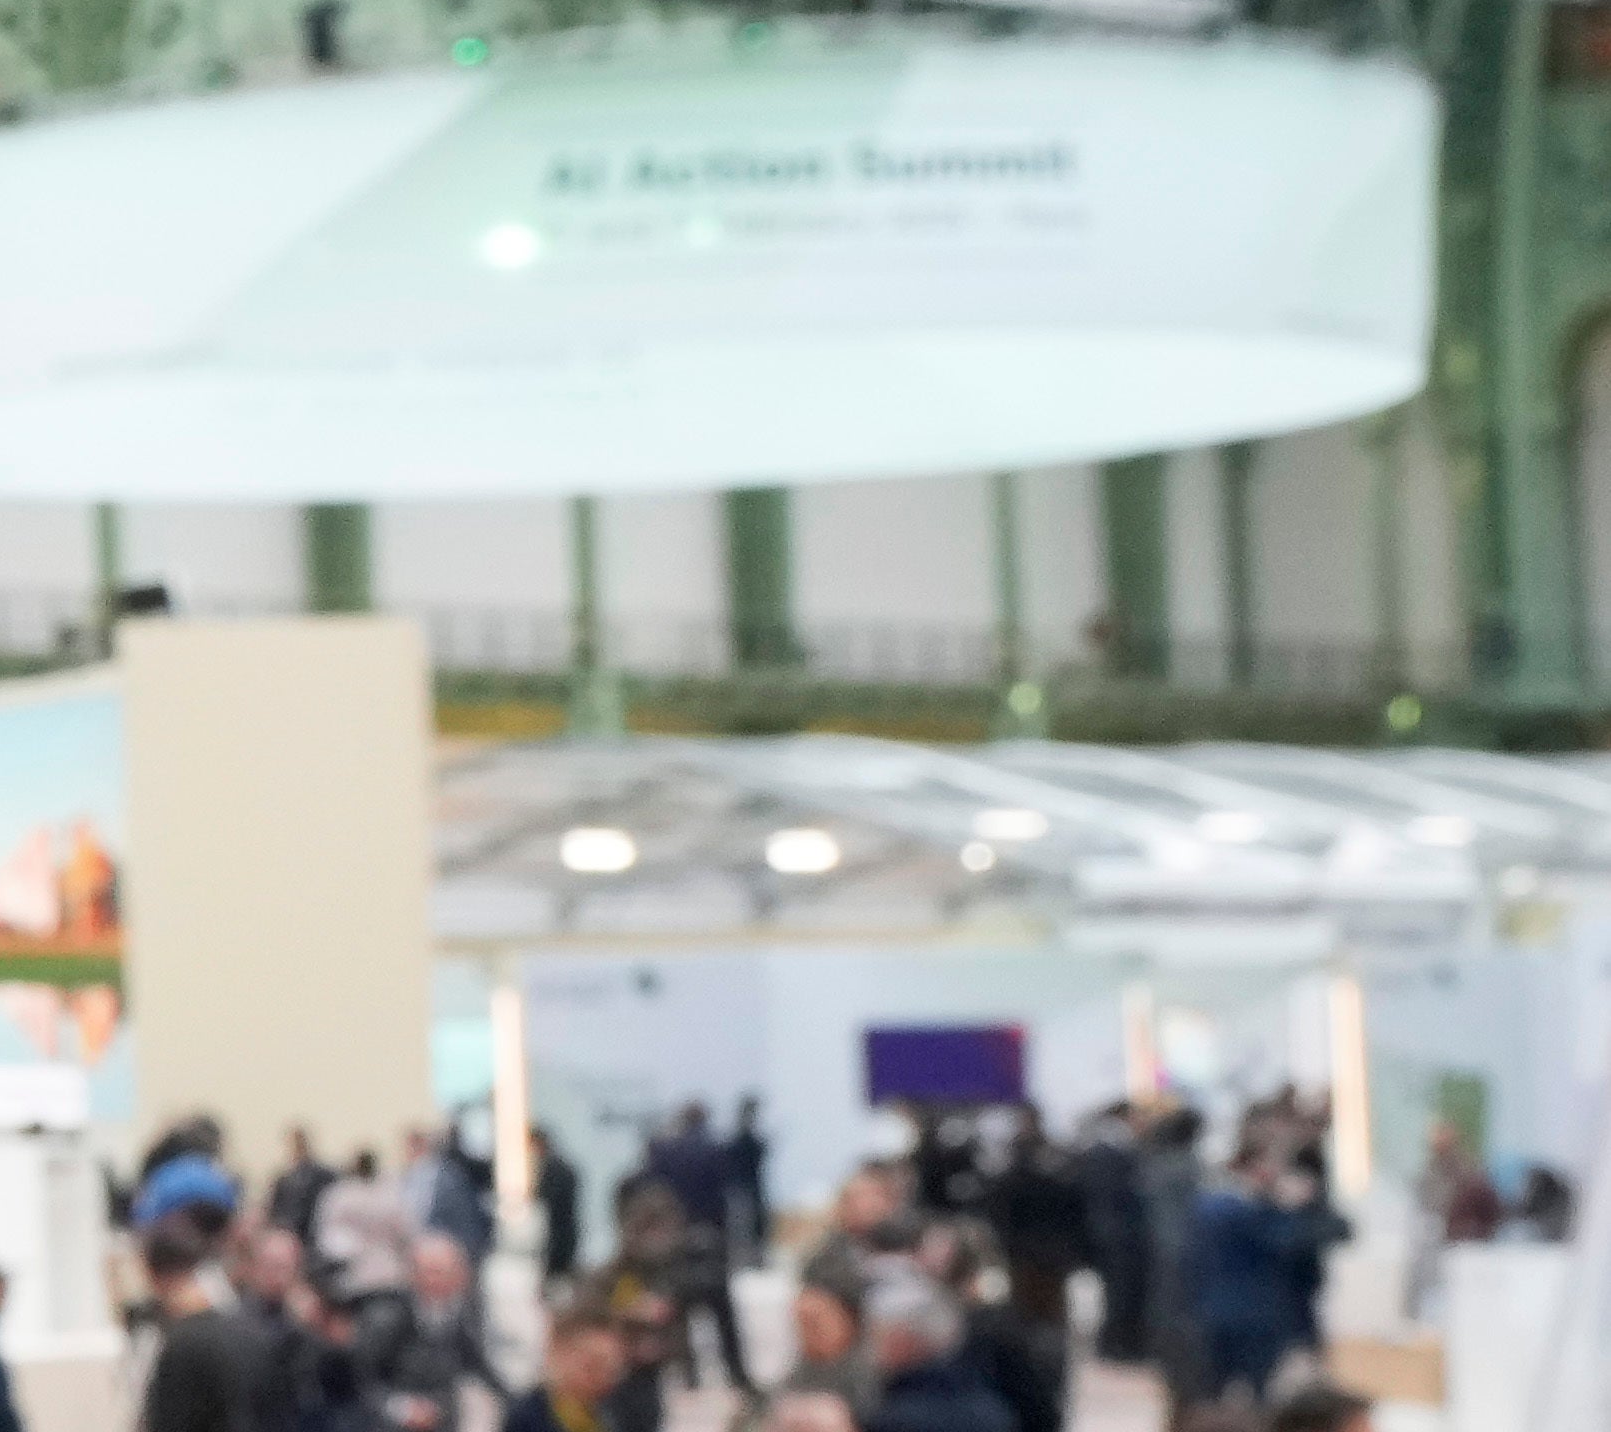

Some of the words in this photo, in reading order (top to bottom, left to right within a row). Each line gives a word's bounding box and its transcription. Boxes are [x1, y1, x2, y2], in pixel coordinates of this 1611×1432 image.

[544, 153, 604, 195] AI
[627, 147, 824, 192] Action
[849, 140, 1078, 183] Summit
